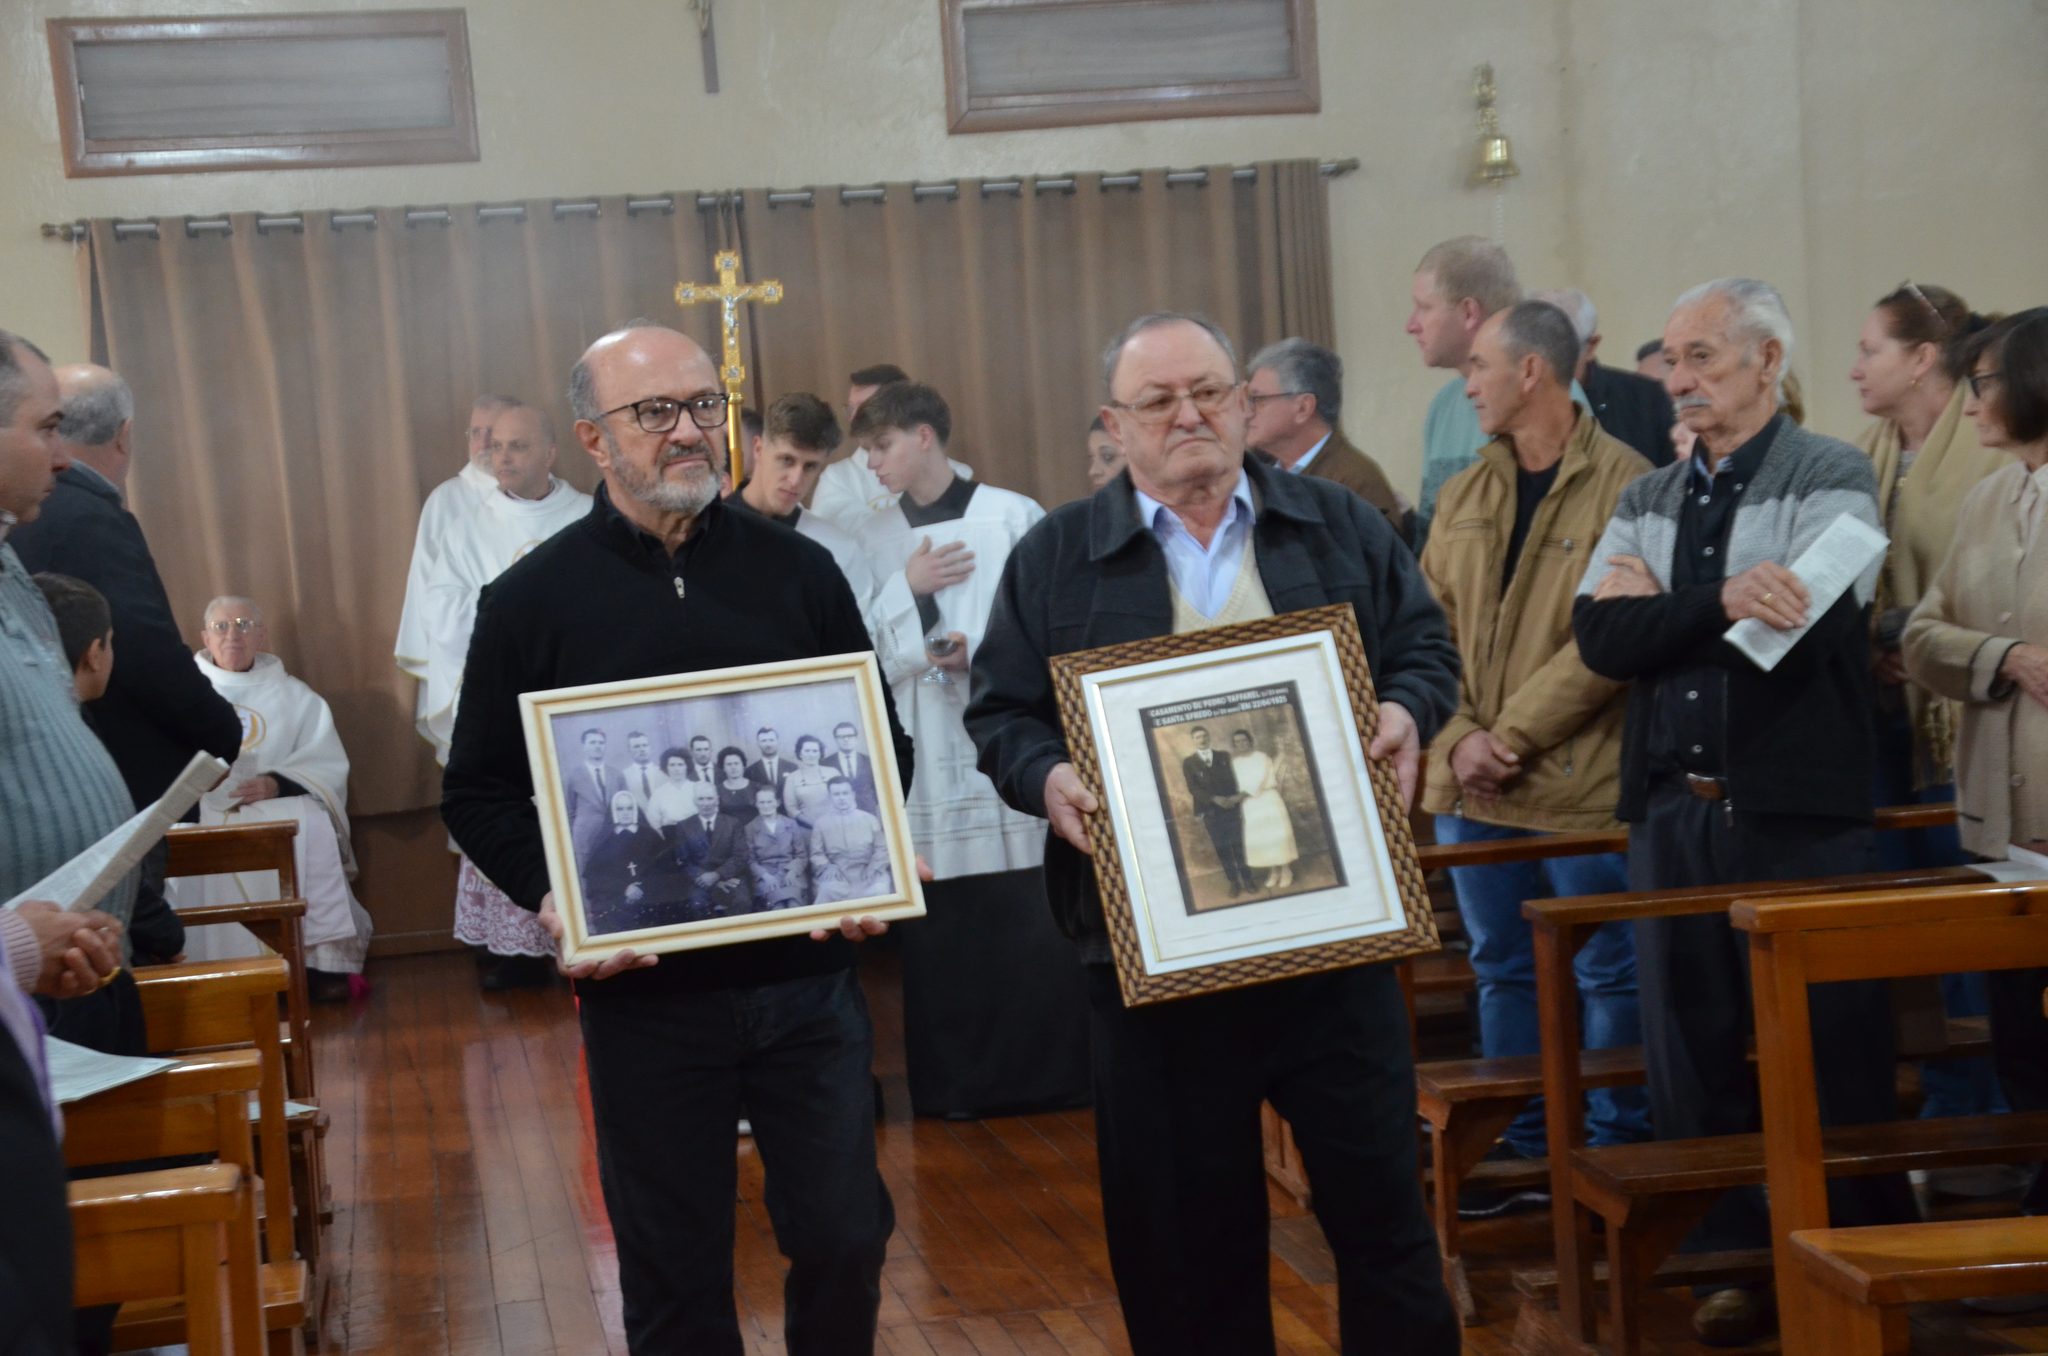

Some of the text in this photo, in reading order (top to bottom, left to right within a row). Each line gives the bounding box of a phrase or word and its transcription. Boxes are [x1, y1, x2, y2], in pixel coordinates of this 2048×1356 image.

[1151, 703, 1192, 717] CASAMENTO
[1193, 702, 1202, 710] DE
[1204, 697, 1227, 708] PEDRO
[1162, 715, 1185, 726] SANTA
